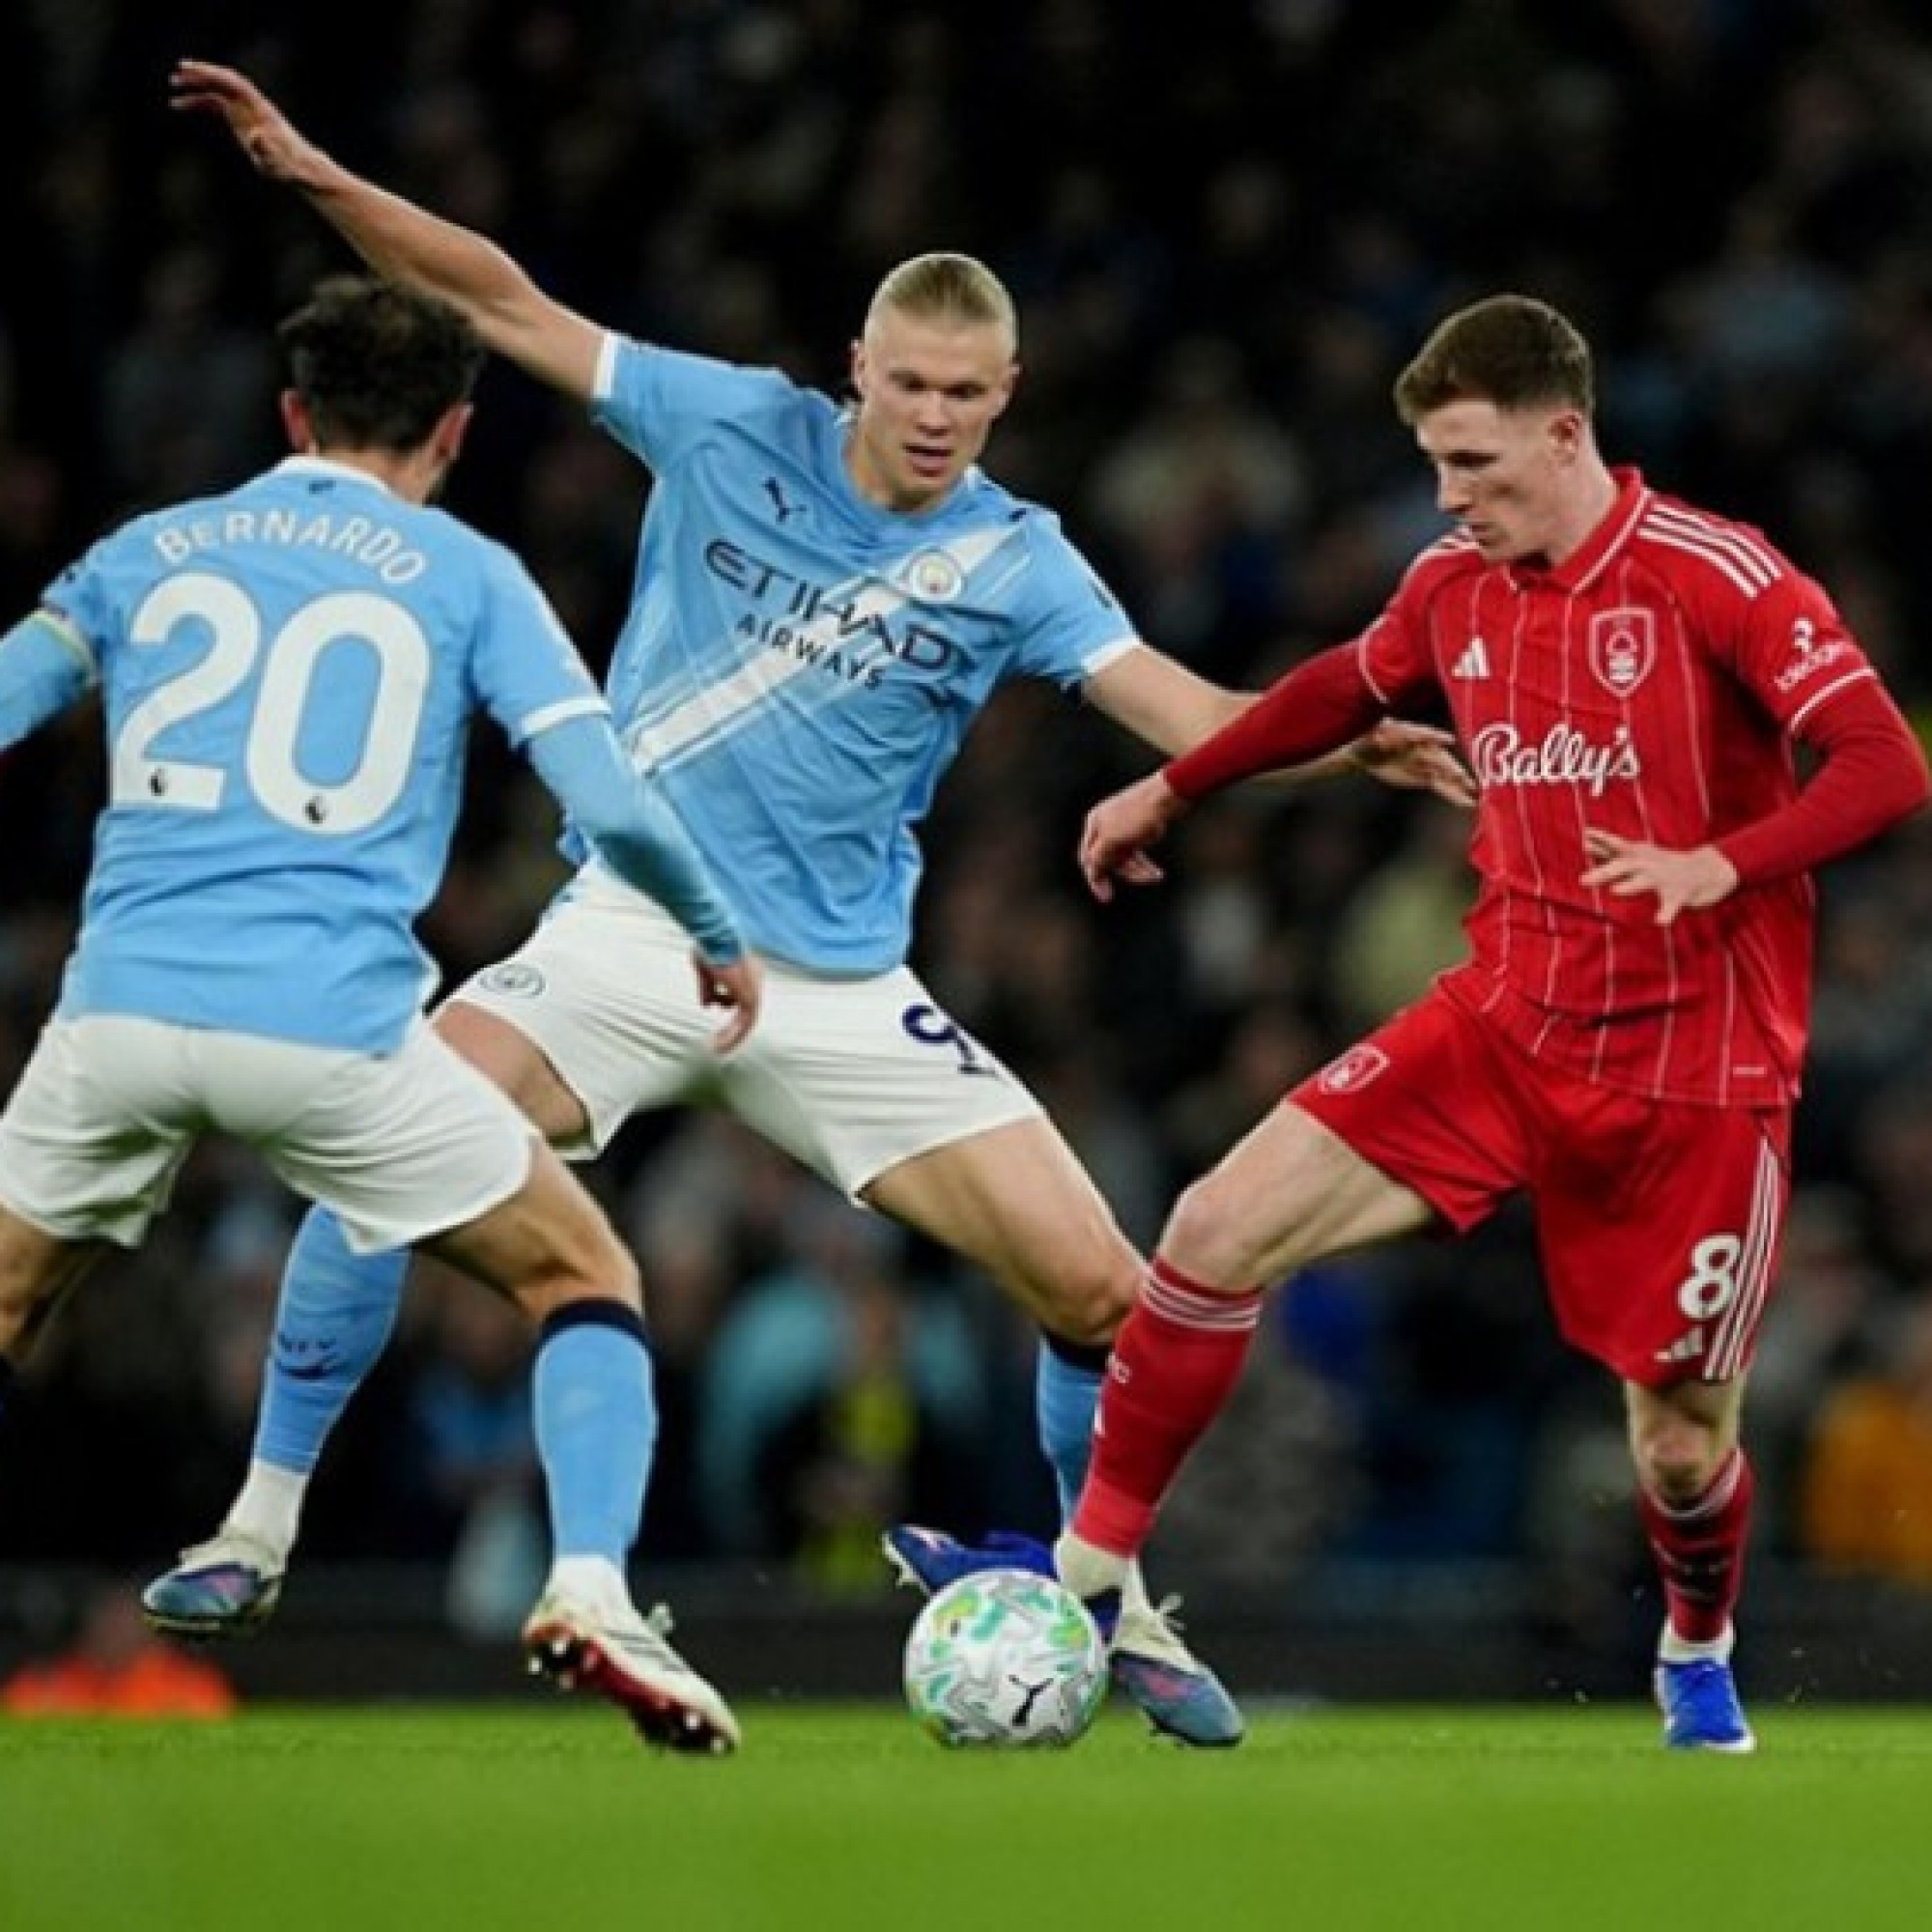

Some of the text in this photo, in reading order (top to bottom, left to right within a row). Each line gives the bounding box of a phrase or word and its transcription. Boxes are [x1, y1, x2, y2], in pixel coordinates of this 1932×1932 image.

[154, 508, 426, 583] BERNARDO
[705, 538, 953, 670] ETIHAD
[737, 611, 885, 689] AIRWAYS
[110, 574, 431, 833] 20
[1472, 722, 1640, 797] Bally's
[1678, 1235, 1740, 1318] 8
